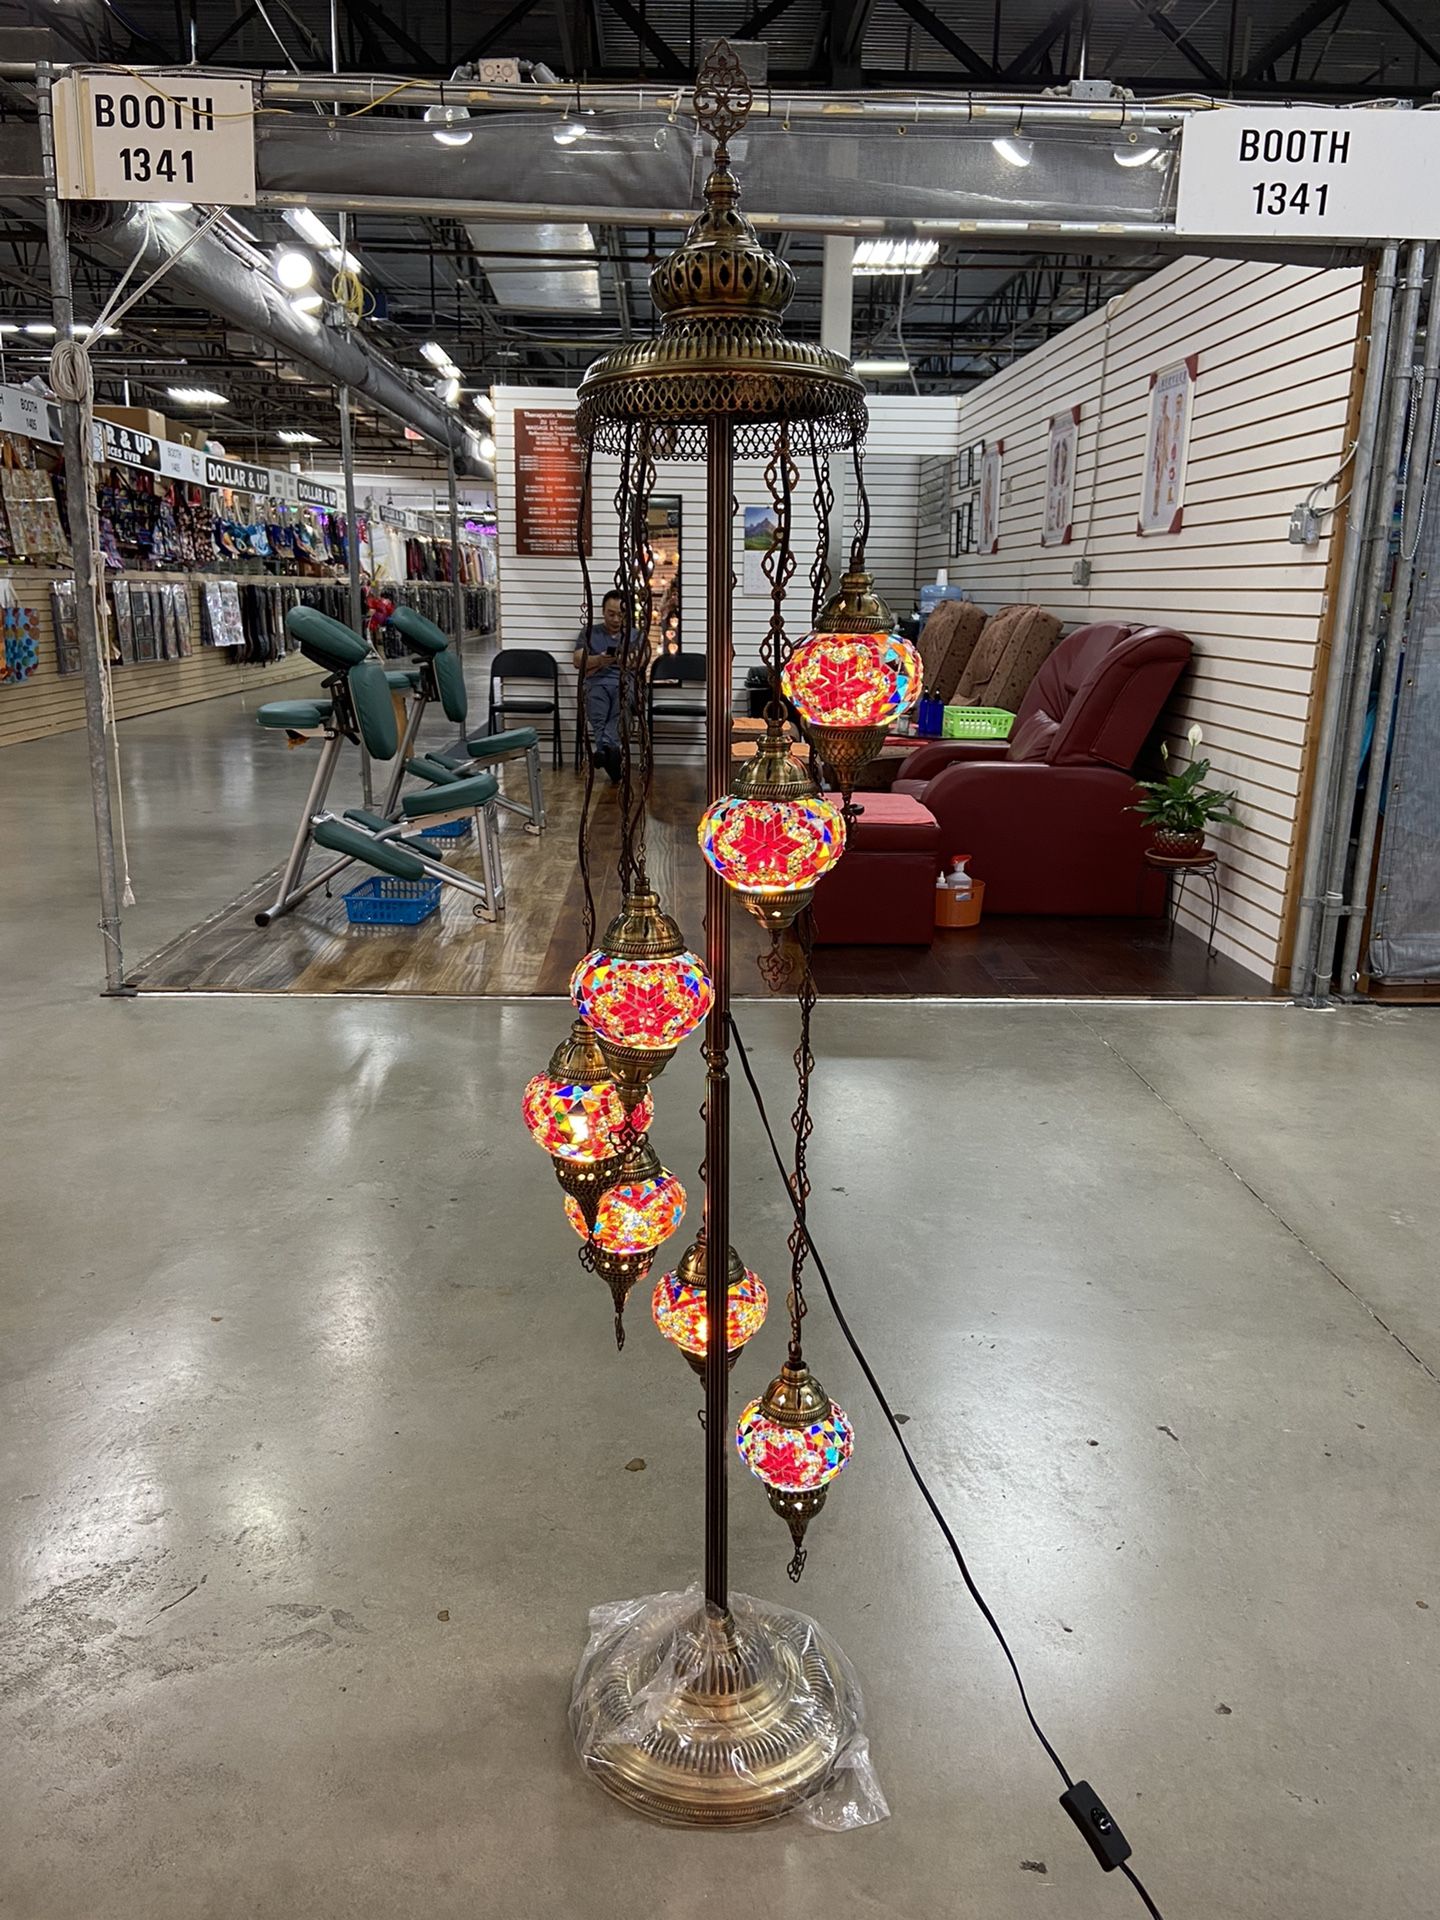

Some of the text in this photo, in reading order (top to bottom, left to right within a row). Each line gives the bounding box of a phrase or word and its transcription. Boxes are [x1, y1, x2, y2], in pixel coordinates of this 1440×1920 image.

[94, 94, 214, 131] BOOTH
[1239, 129, 1350, 164] BOOTH
[119, 147, 194, 183] 1341
[1252, 182, 1329, 216] 1341
[120, 430, 132, 450] &
[134, 434, 153, 456] UP
[124, 450, 141, 464] EVER
[208, 462, 246, 488] DOLLAR
[248, 471, 256, 489] &
[257, 473, 268, 490] UP
[298, 482, 323, 503] DOLLAR
[323, 489, 329, 504] &
[328, 490, 337, 506] UP
